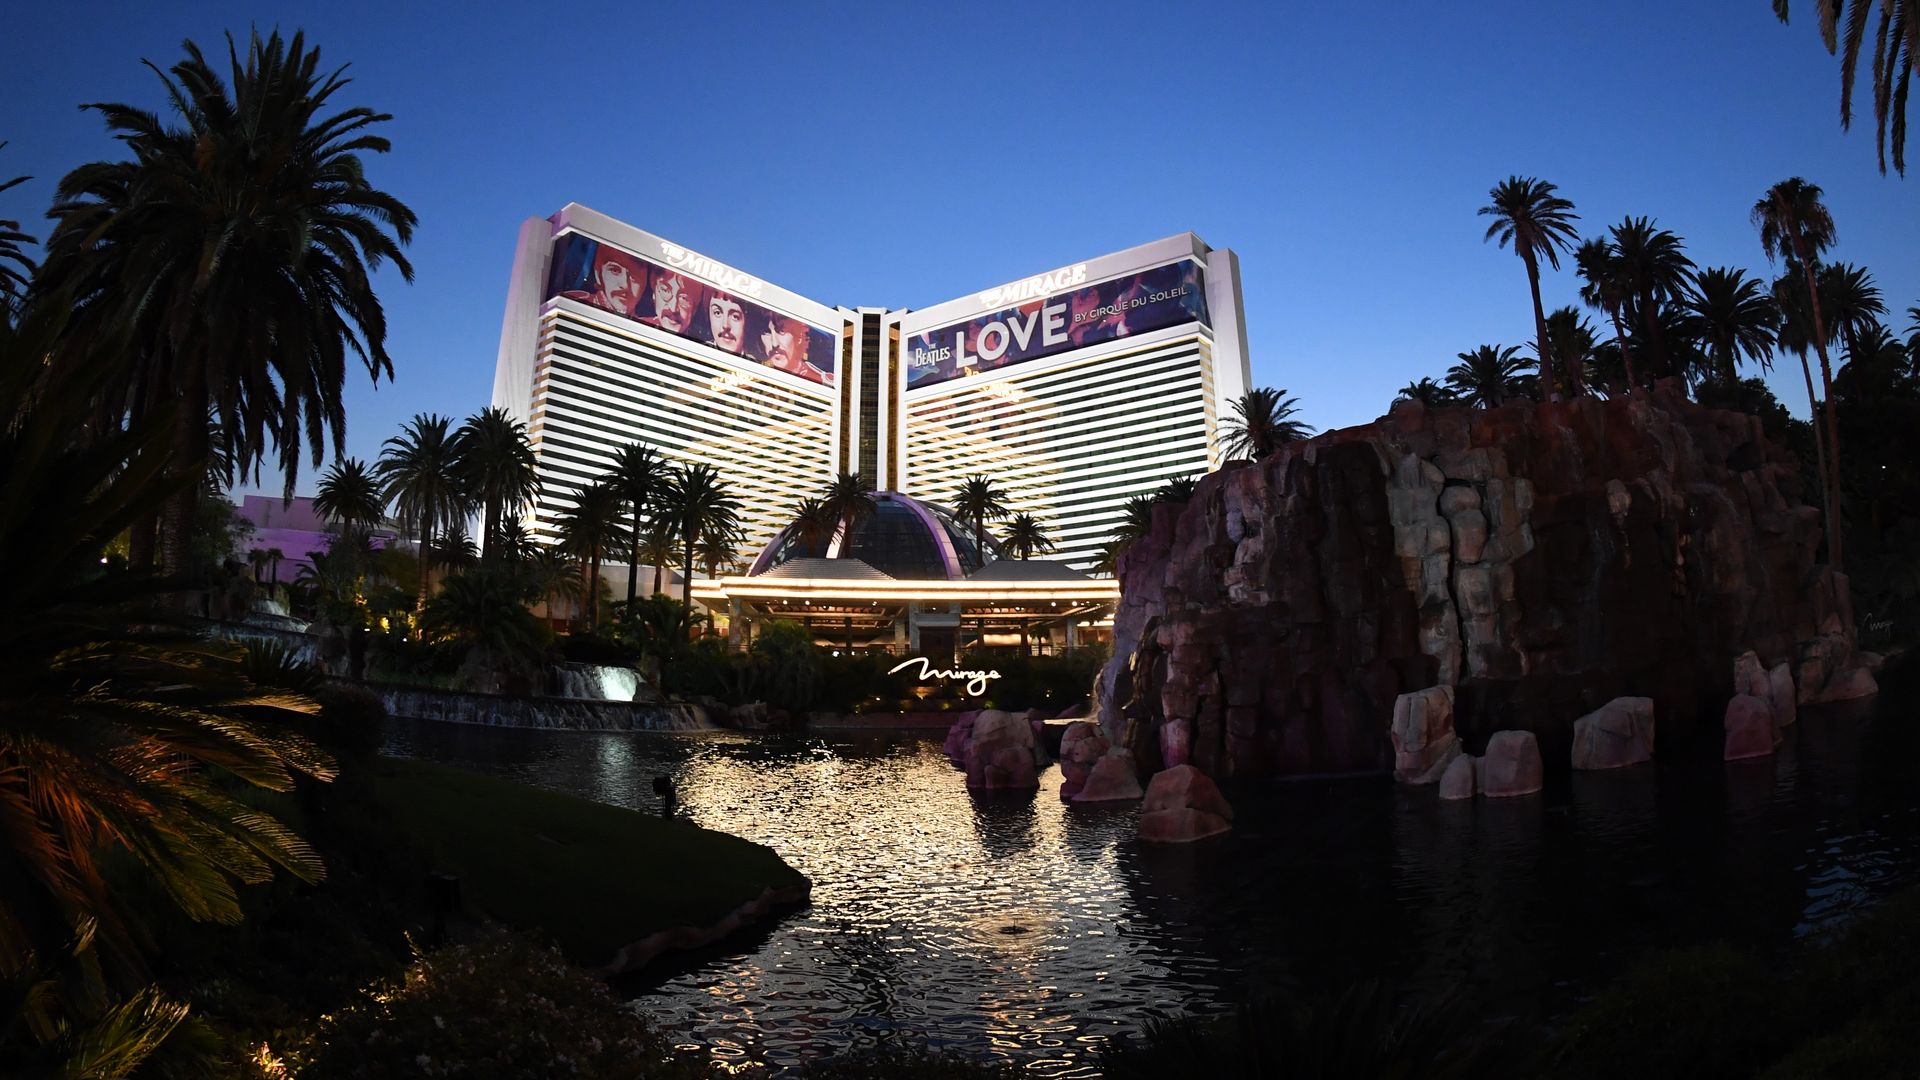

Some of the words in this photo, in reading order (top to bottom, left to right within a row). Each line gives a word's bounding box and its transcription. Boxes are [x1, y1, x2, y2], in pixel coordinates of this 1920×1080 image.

[668, 253, 763, 297] MIRAGE
[988, 264, 1087, 308] MIRAGE
[1074, 312, 1088, 323] BY
[1090, 302, 1128, 319] CIRQUE
[1131, 297, 1147, 308] DU
[1150, 287, 1188, 303] SOLEIL
[915, 347, 951, 368] BEATLES
[956, 303, 1068, 368] LOVE
